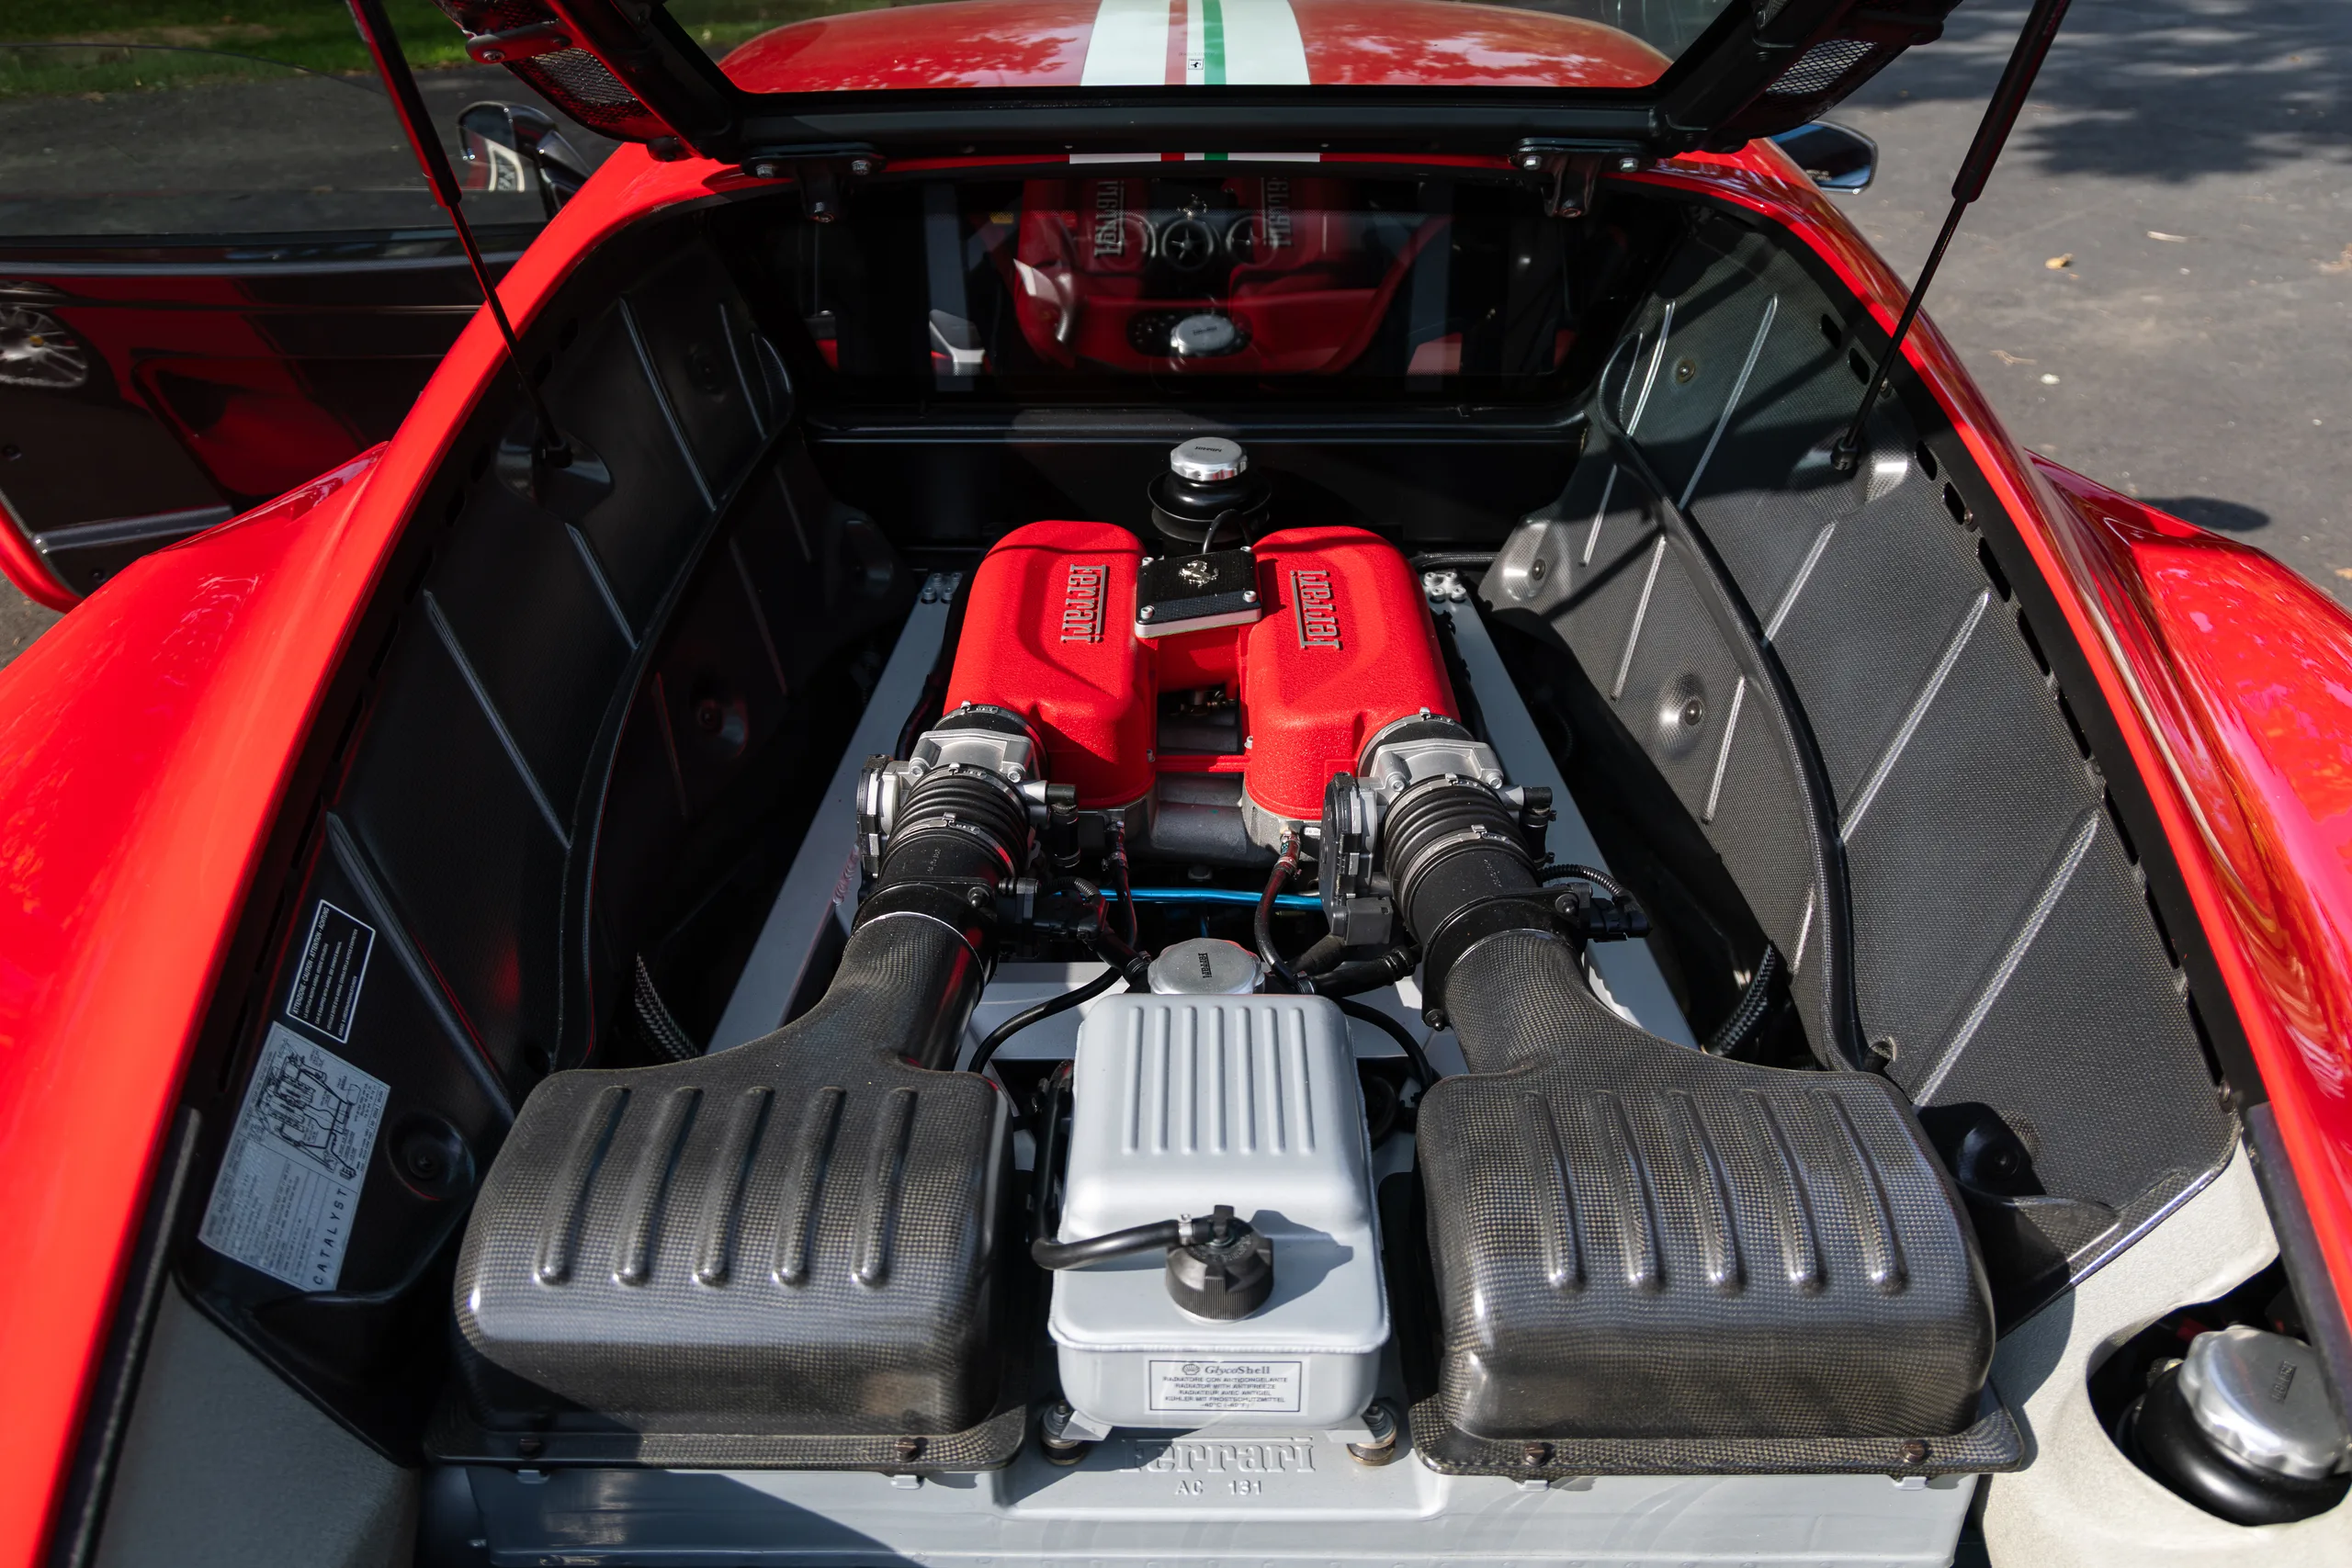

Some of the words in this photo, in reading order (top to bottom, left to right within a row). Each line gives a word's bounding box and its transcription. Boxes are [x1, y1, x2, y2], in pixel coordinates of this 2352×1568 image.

[1060, 564, 1107, 645] Ferrari
[1290, 570, 1340, 650] Ferrari
[292, 984, 306, 1014] ATTENZIONE
[302, 959, 313, 982] CAUTION
[310, 931, 322, 958] ATTENTION
[318, 907, 330, 930] ACHTUNG
[313, 1188, 348, 1286] CATALYST
[1204, 1365, 1271, 1375] GlycoShell
[1119, 1436, 1317, 1474] Ferrari
[1175, 1480, 1204, 1496] AC
